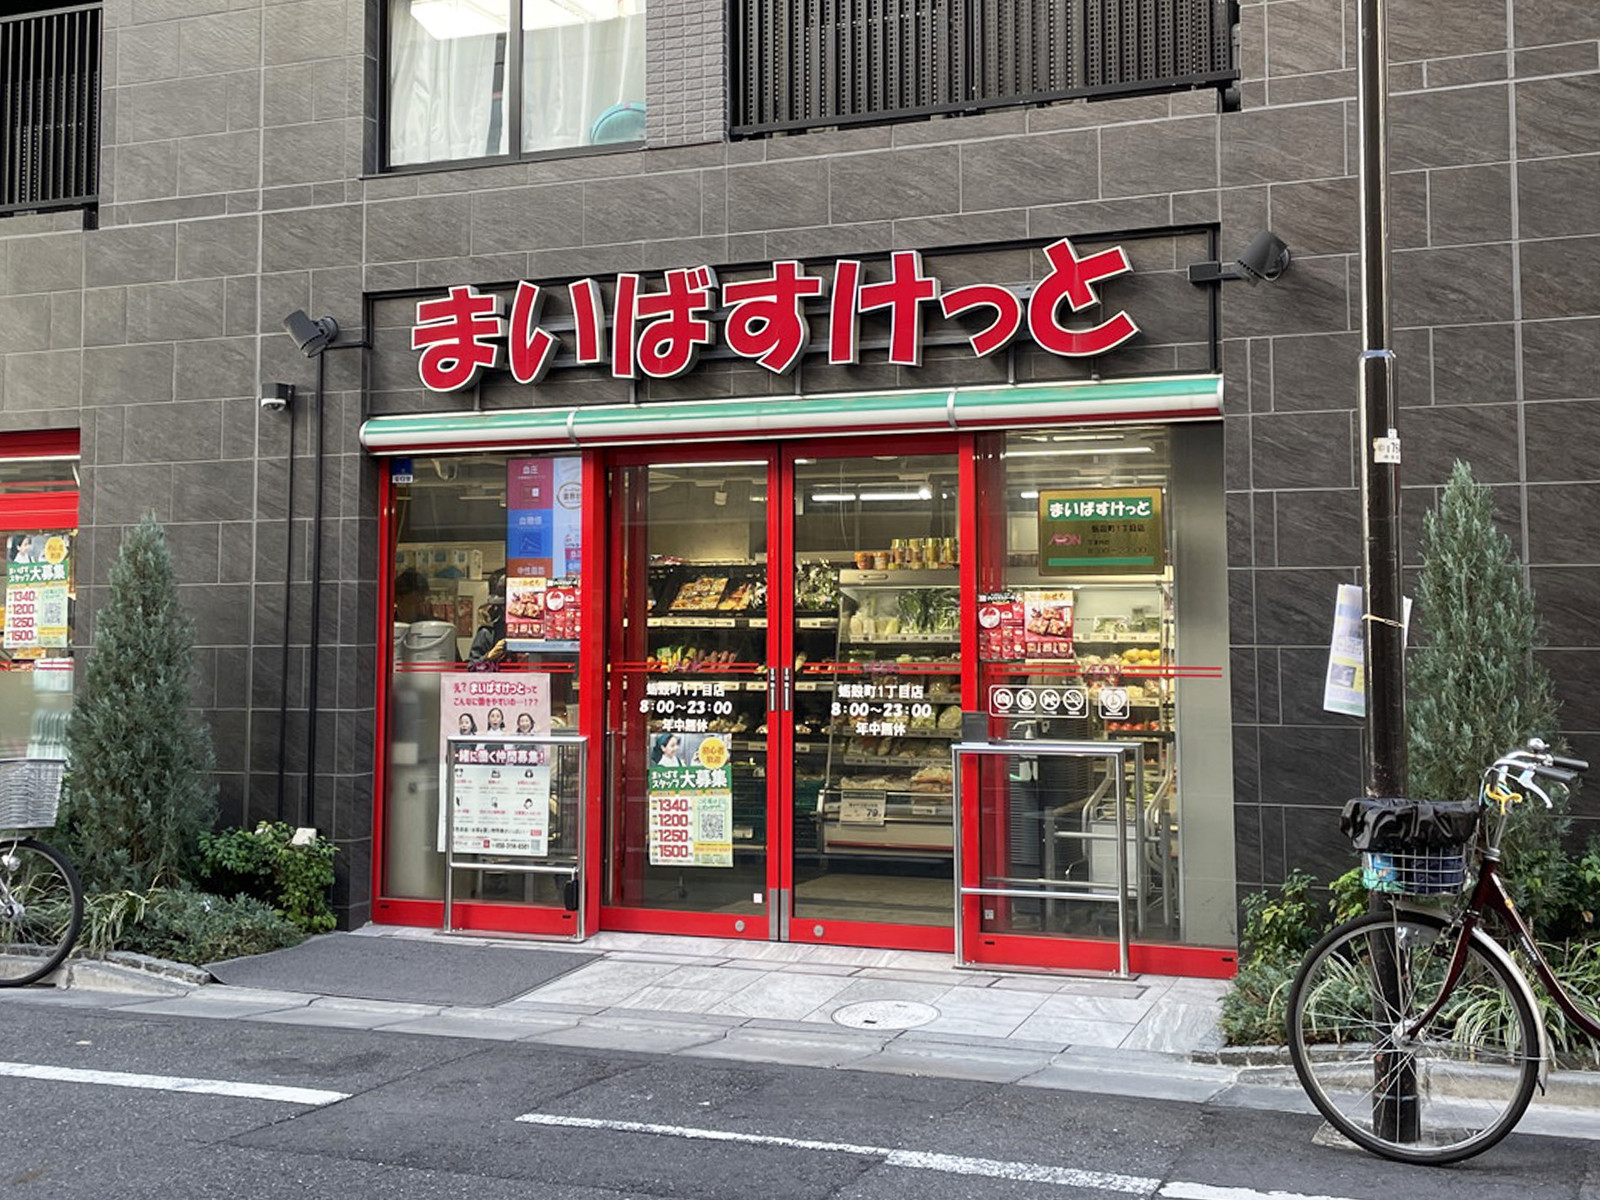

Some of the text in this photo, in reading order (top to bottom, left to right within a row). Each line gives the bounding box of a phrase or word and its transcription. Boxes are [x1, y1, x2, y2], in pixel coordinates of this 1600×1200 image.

[410, 238, 1140, 392] まいばすけっと
[1049, 501, 1151, 517] まいばすけっと
[662, 719, 708, 732] 年中無休
[856, 722, 906, 736] 年中無休
[680, 769, 728, 789] 大募集
[659, 799, 688, 811] 1340
[659, 814, 688, 827] 1200
[659, 829, 688, 842] 1250
[659, 844, 688, 857] 1500
